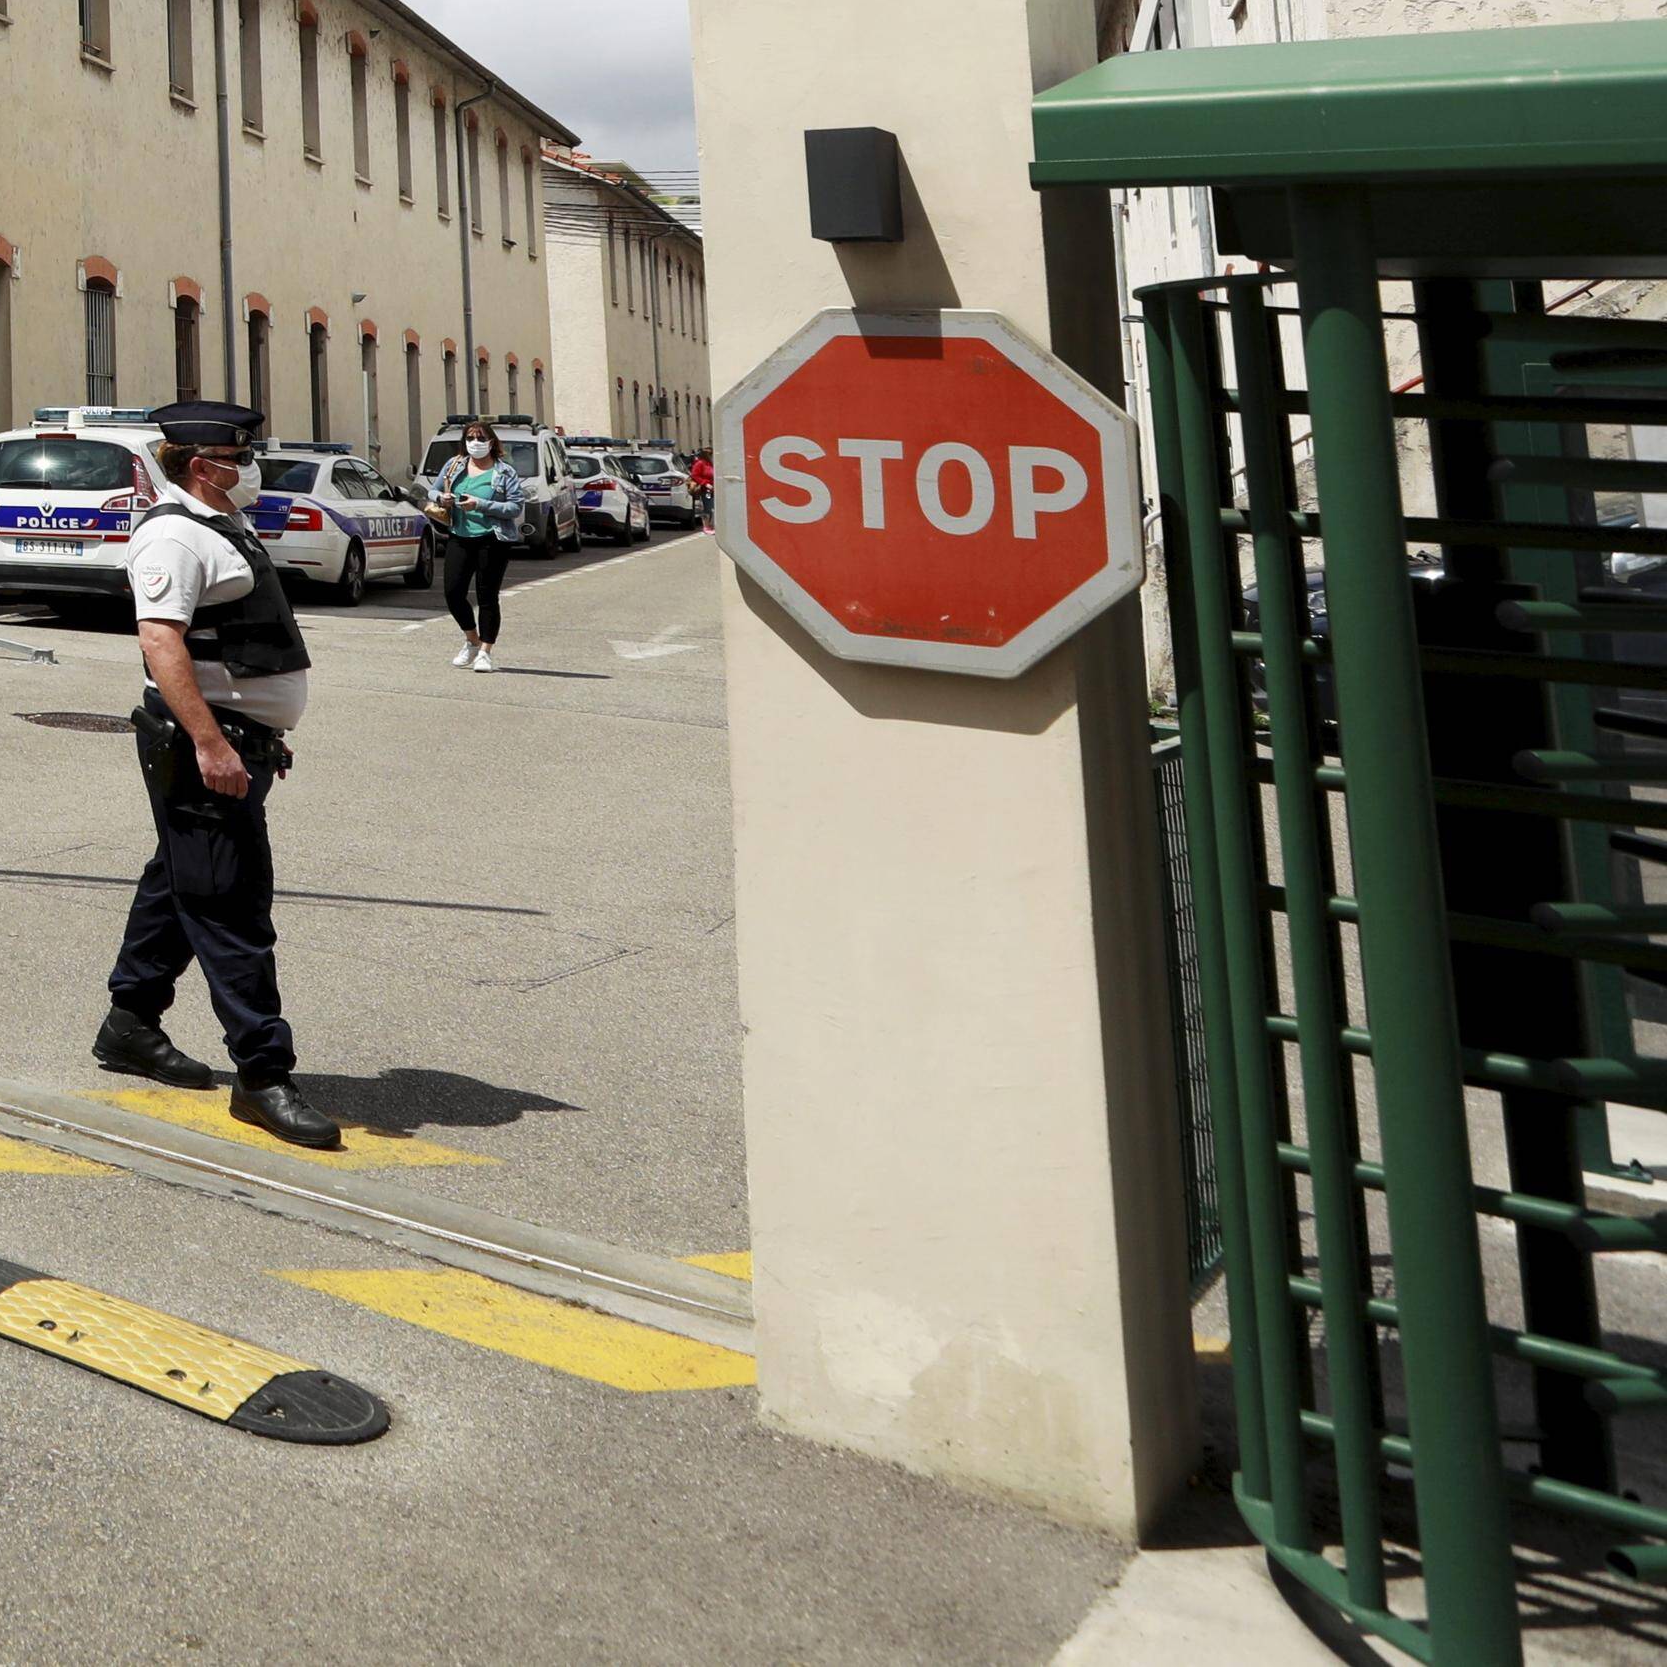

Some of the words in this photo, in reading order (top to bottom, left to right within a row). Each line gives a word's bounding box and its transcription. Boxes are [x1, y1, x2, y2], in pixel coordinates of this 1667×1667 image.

[759, 435, 1088, 539] STOP
[17, 516, 79, 529] POLICE
[368, 518, 402, 537] POLICE
